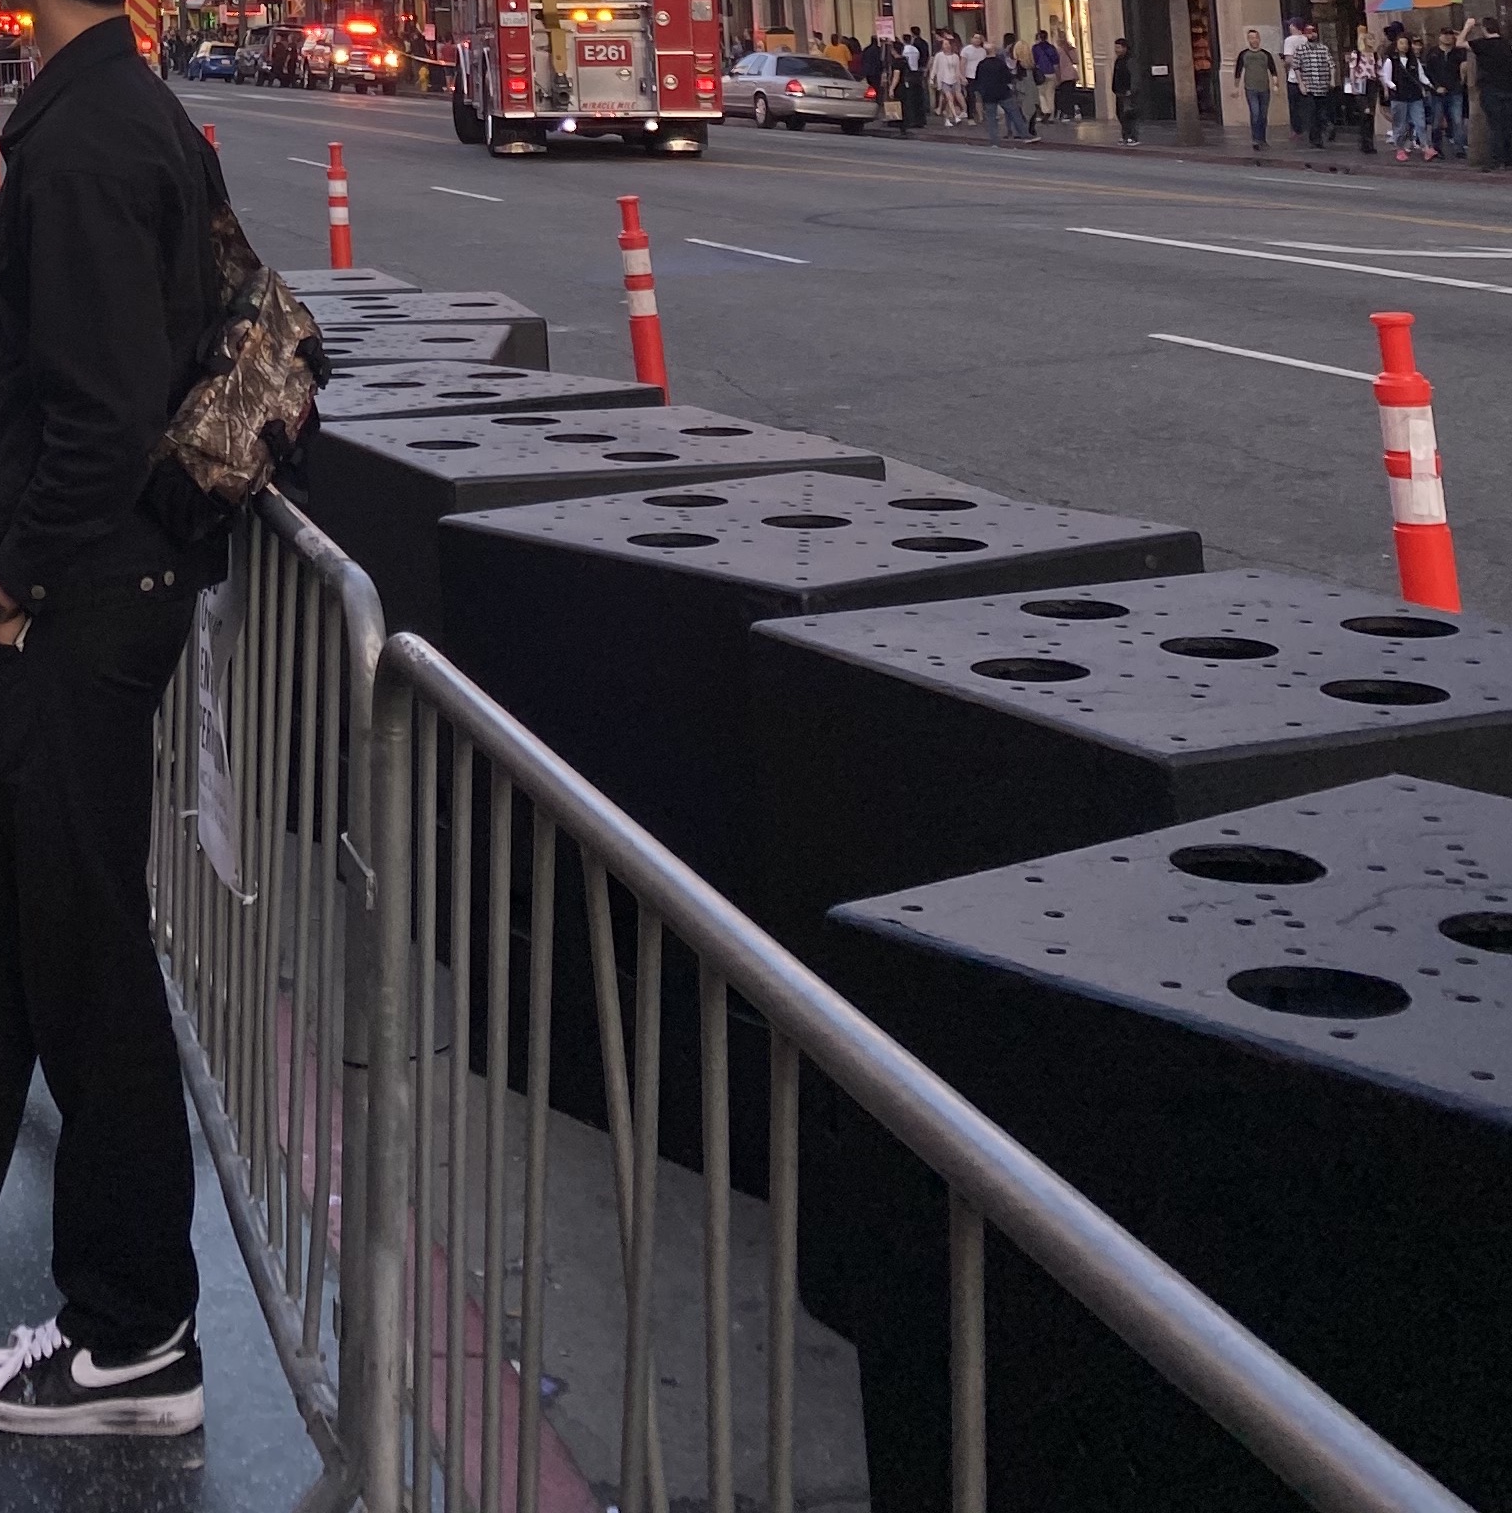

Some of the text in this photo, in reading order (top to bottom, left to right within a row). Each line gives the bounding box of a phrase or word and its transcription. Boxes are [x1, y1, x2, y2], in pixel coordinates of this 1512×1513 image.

[584, 44, 627, 61] E261
[581, 101, 637, 110] MIRACLE MILE
